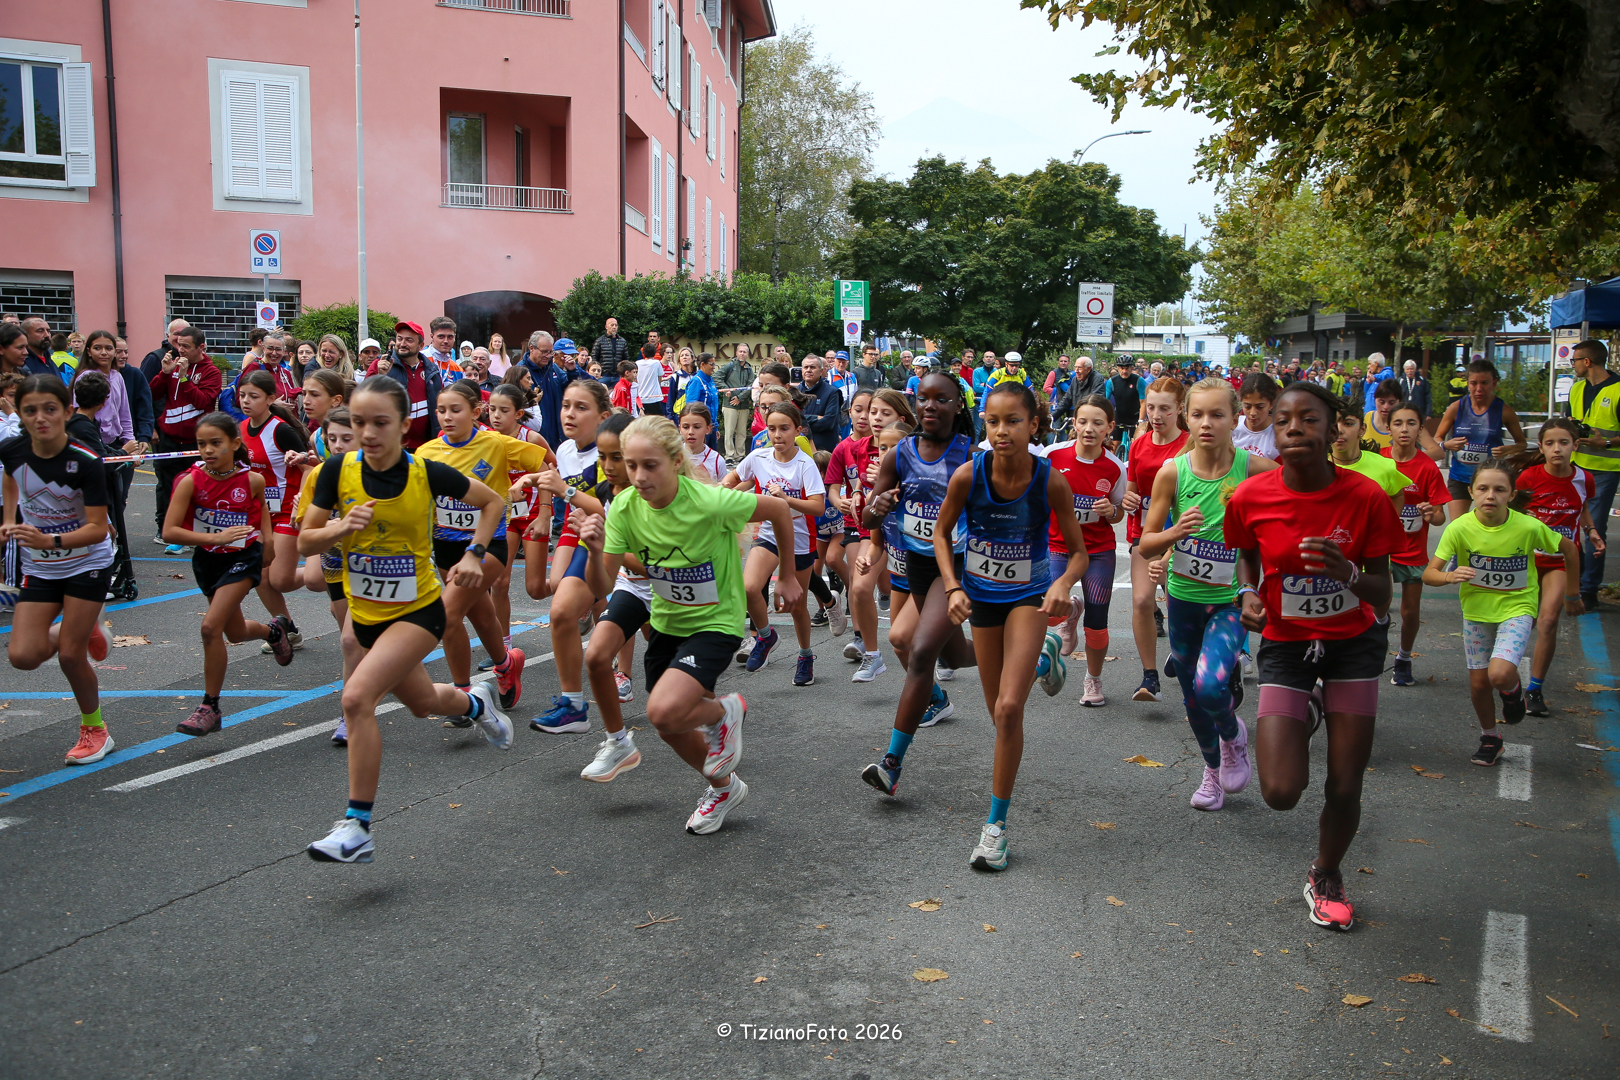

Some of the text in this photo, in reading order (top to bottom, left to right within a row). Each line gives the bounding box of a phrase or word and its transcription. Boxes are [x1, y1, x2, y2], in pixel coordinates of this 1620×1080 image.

[842, 282, 852, 297] P
[1461, 452, 1480, 462] 486
[446, 512, 474, 527] 149
[914, 521, 932, 537] 45
[1200, 547, 1235, 555] SPORTIVO
[1200, 551, 1235, 560] ITALIANO
[979, 559, 1016, 578] 476
[1189, 559, 1213, 580] 32
[1481, 573, 1515, 587] 499
[362, 578, 400, 598] 277
[670, 585, 695, 601] 53
[1298, 594, 1344, 614] 430
